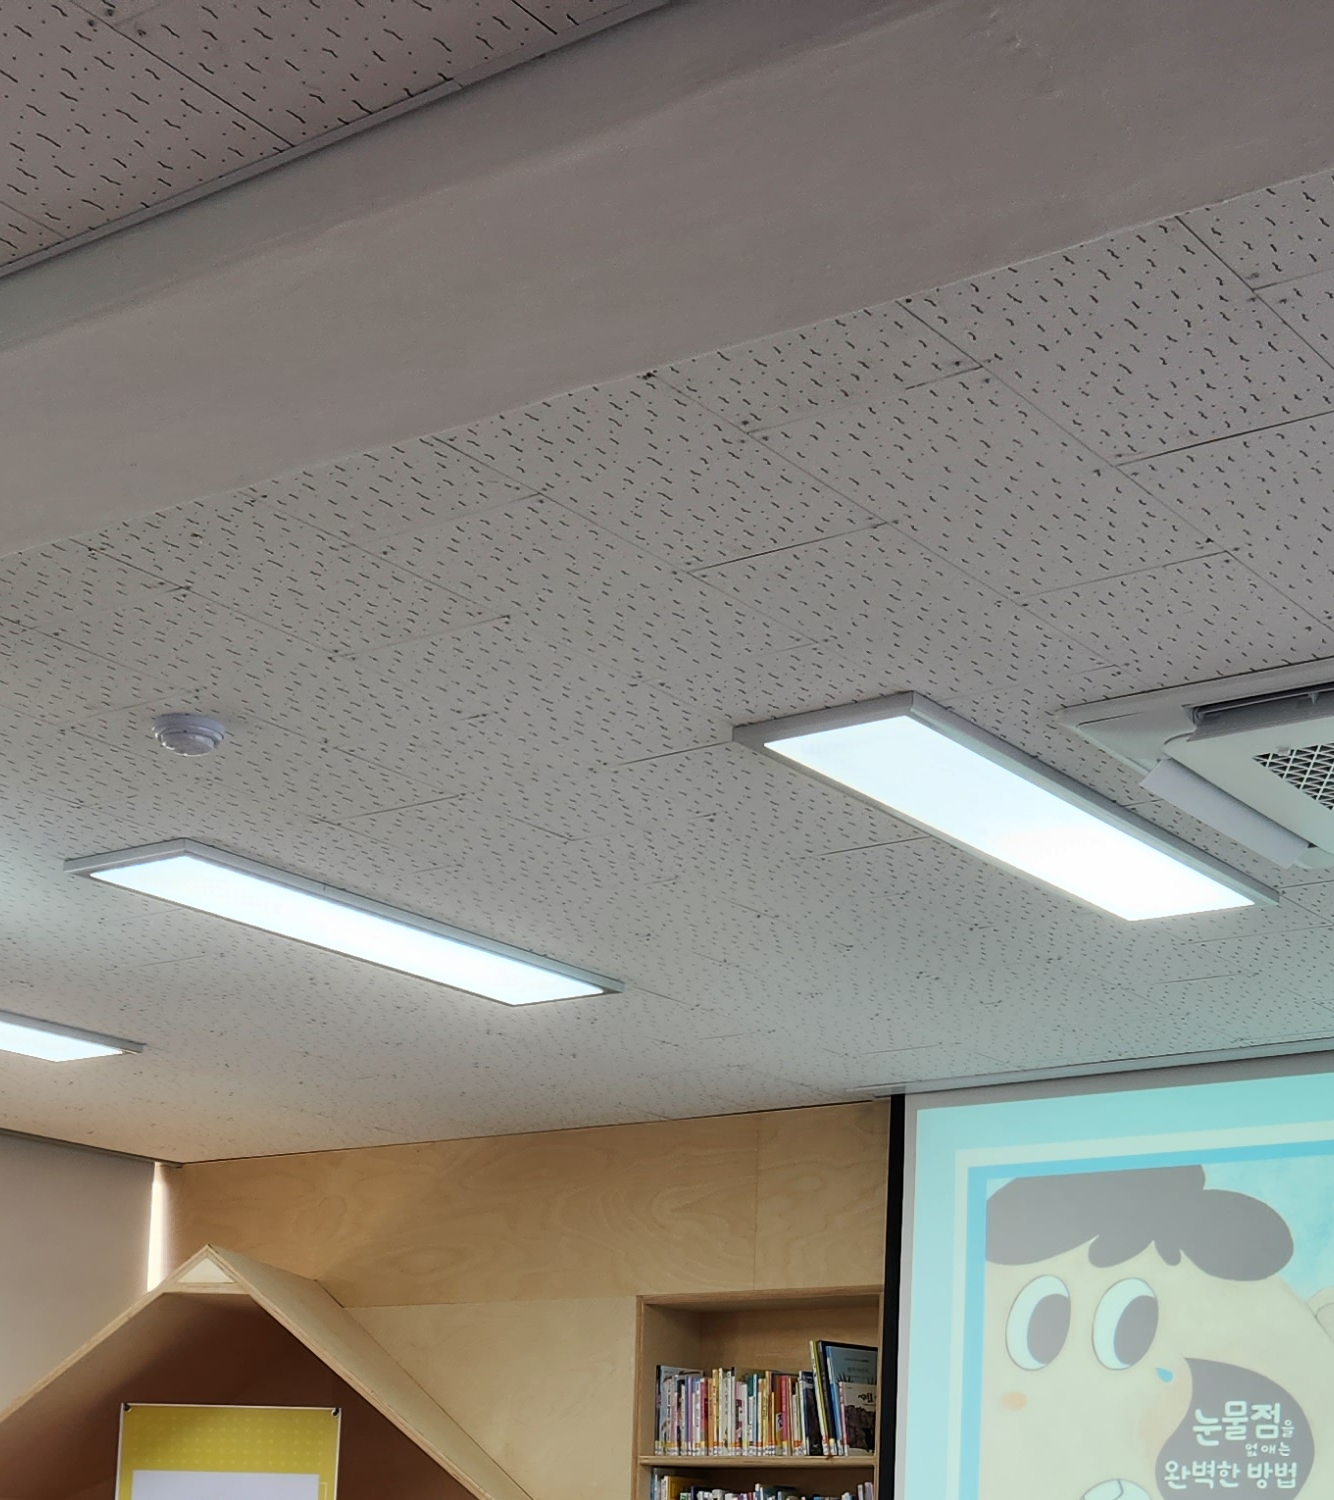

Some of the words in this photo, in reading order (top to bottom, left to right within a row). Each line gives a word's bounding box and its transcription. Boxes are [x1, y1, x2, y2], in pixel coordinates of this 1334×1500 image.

[1245, 1441, 1291, 1458] 없애는
[1164, 1460, 1241, 1489] 완벽한
[1247, 1461, 1297, 1489] 방법
